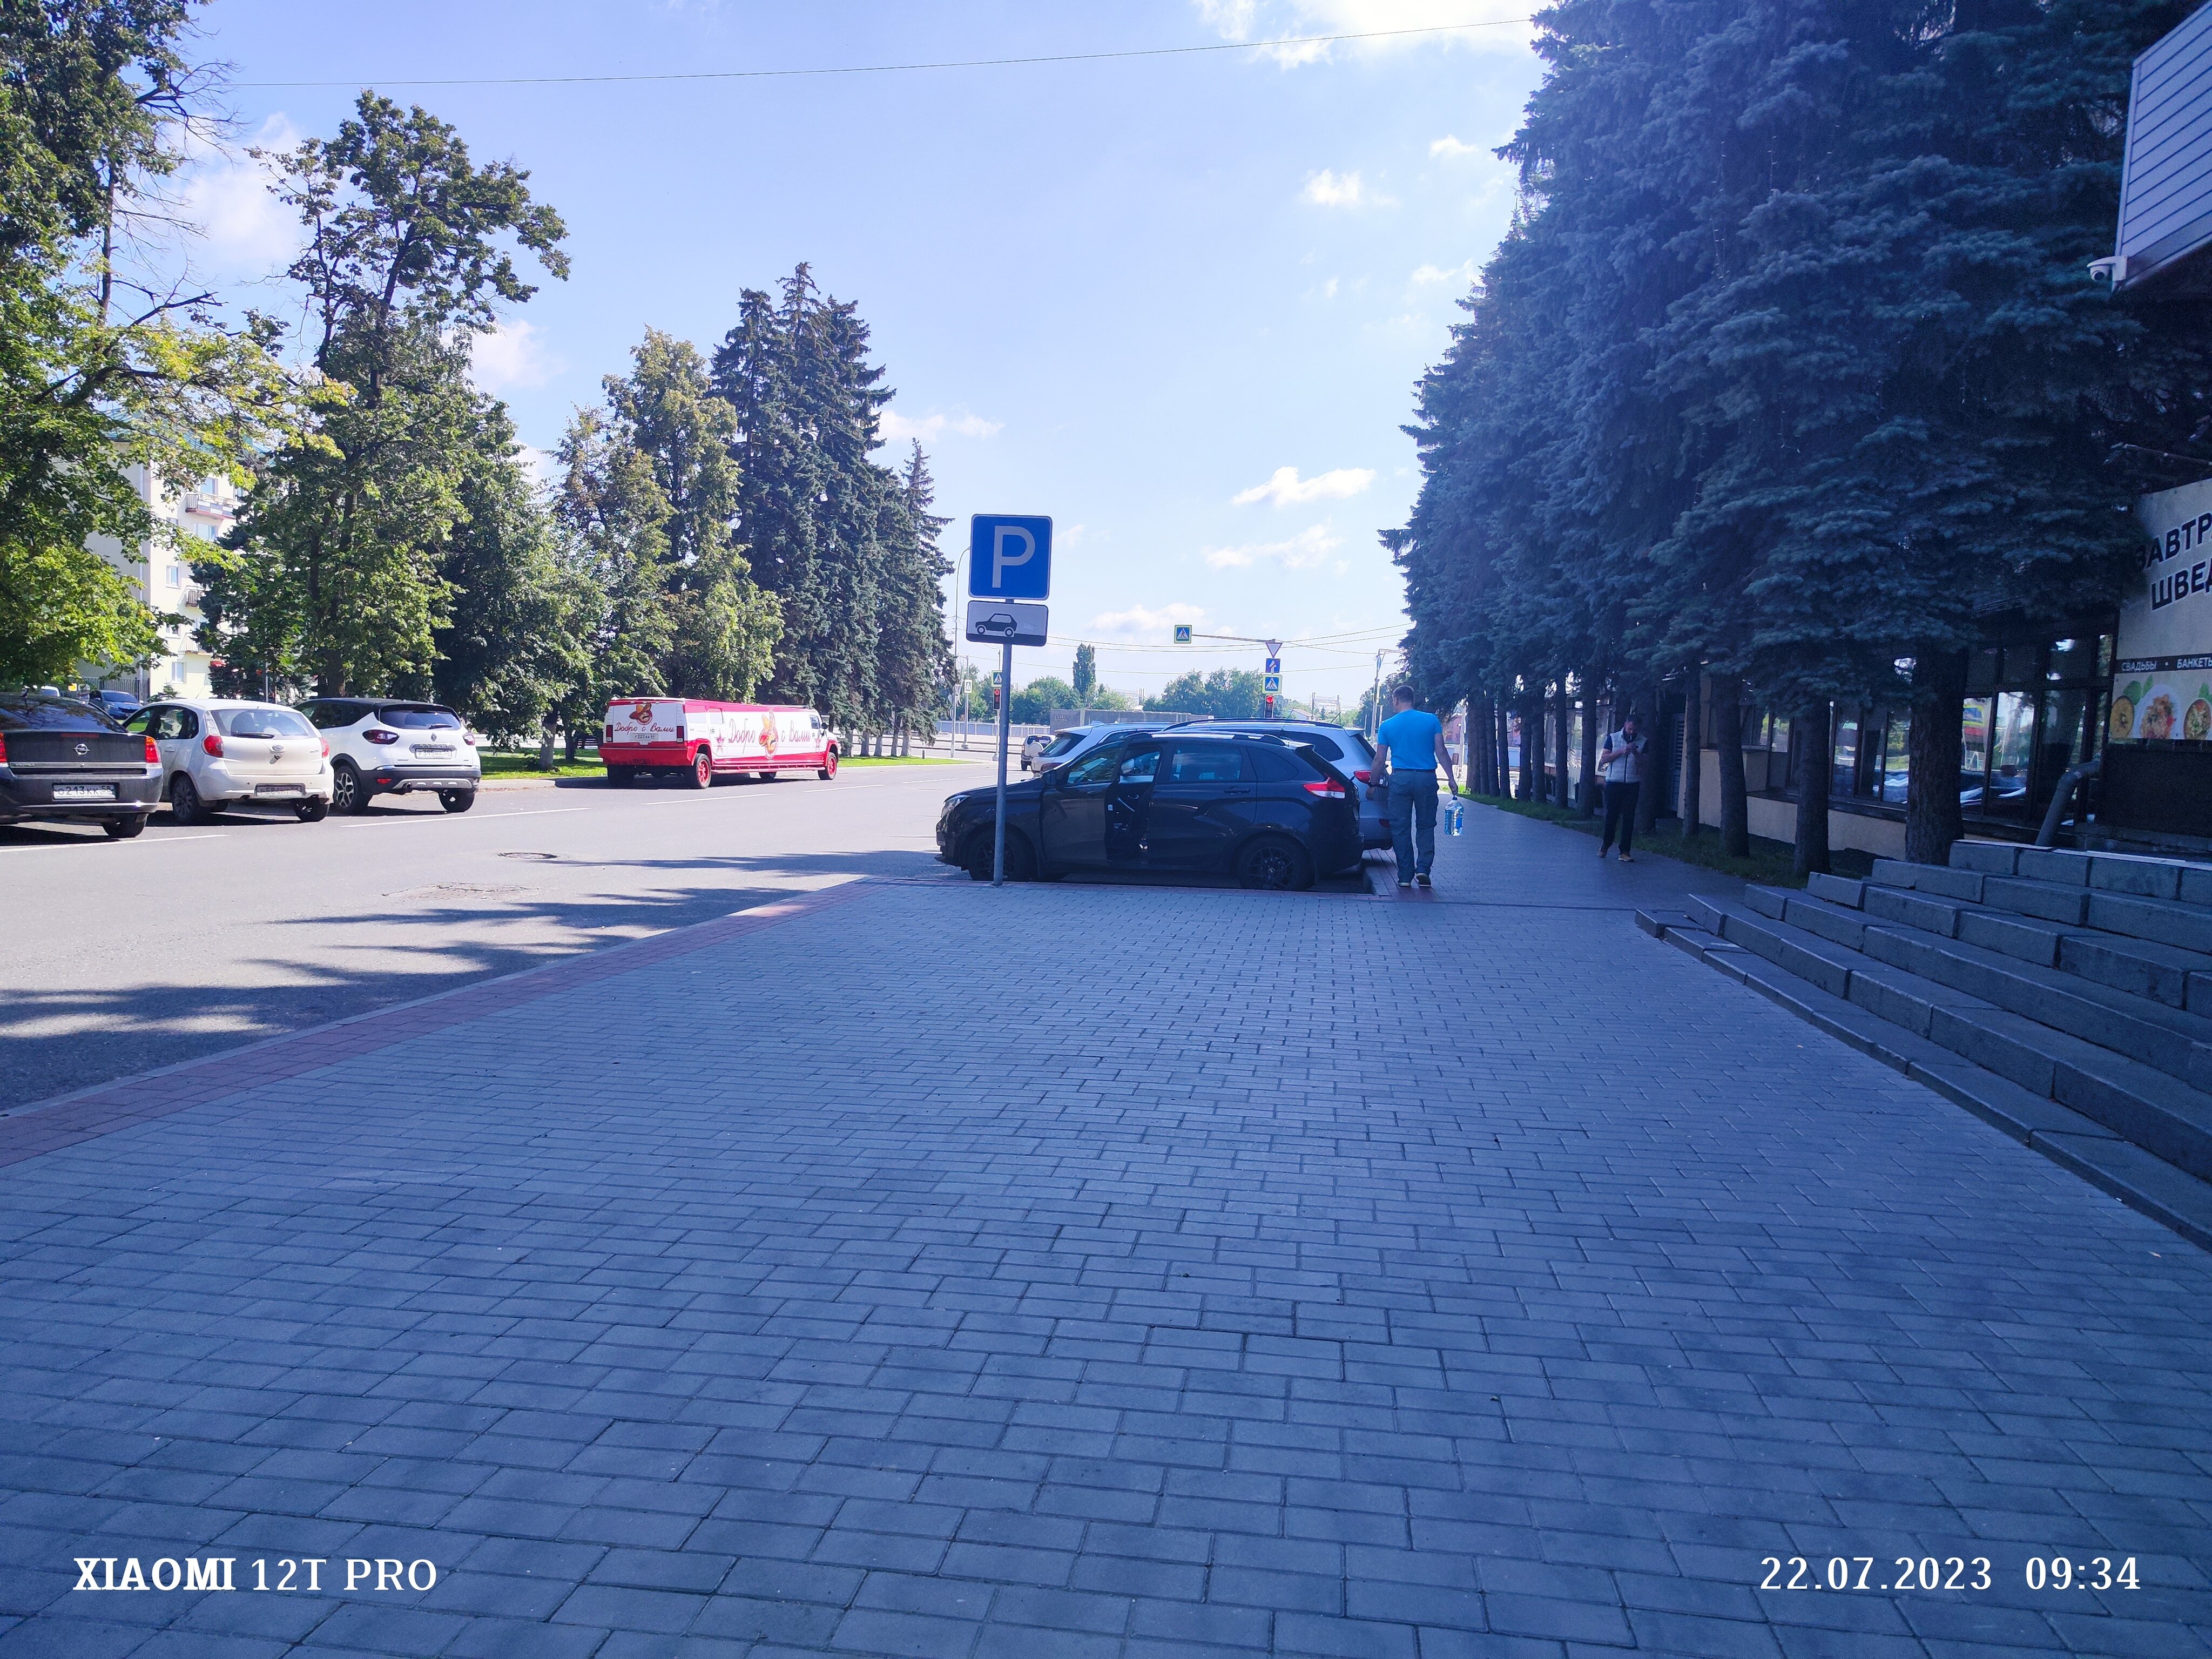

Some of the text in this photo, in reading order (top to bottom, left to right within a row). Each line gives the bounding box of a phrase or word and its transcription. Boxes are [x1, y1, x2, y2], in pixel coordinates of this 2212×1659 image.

[992, 525, 1035, 588] P
[2135, 512, 2212, 571] ЗАВТР
[2121, 660, 2157, 672] СВАДЬБЫ
[615, 721, 638, 735] Добро
[729, 718, 756, 754] Добро
[781, 730, 786, 743] с
